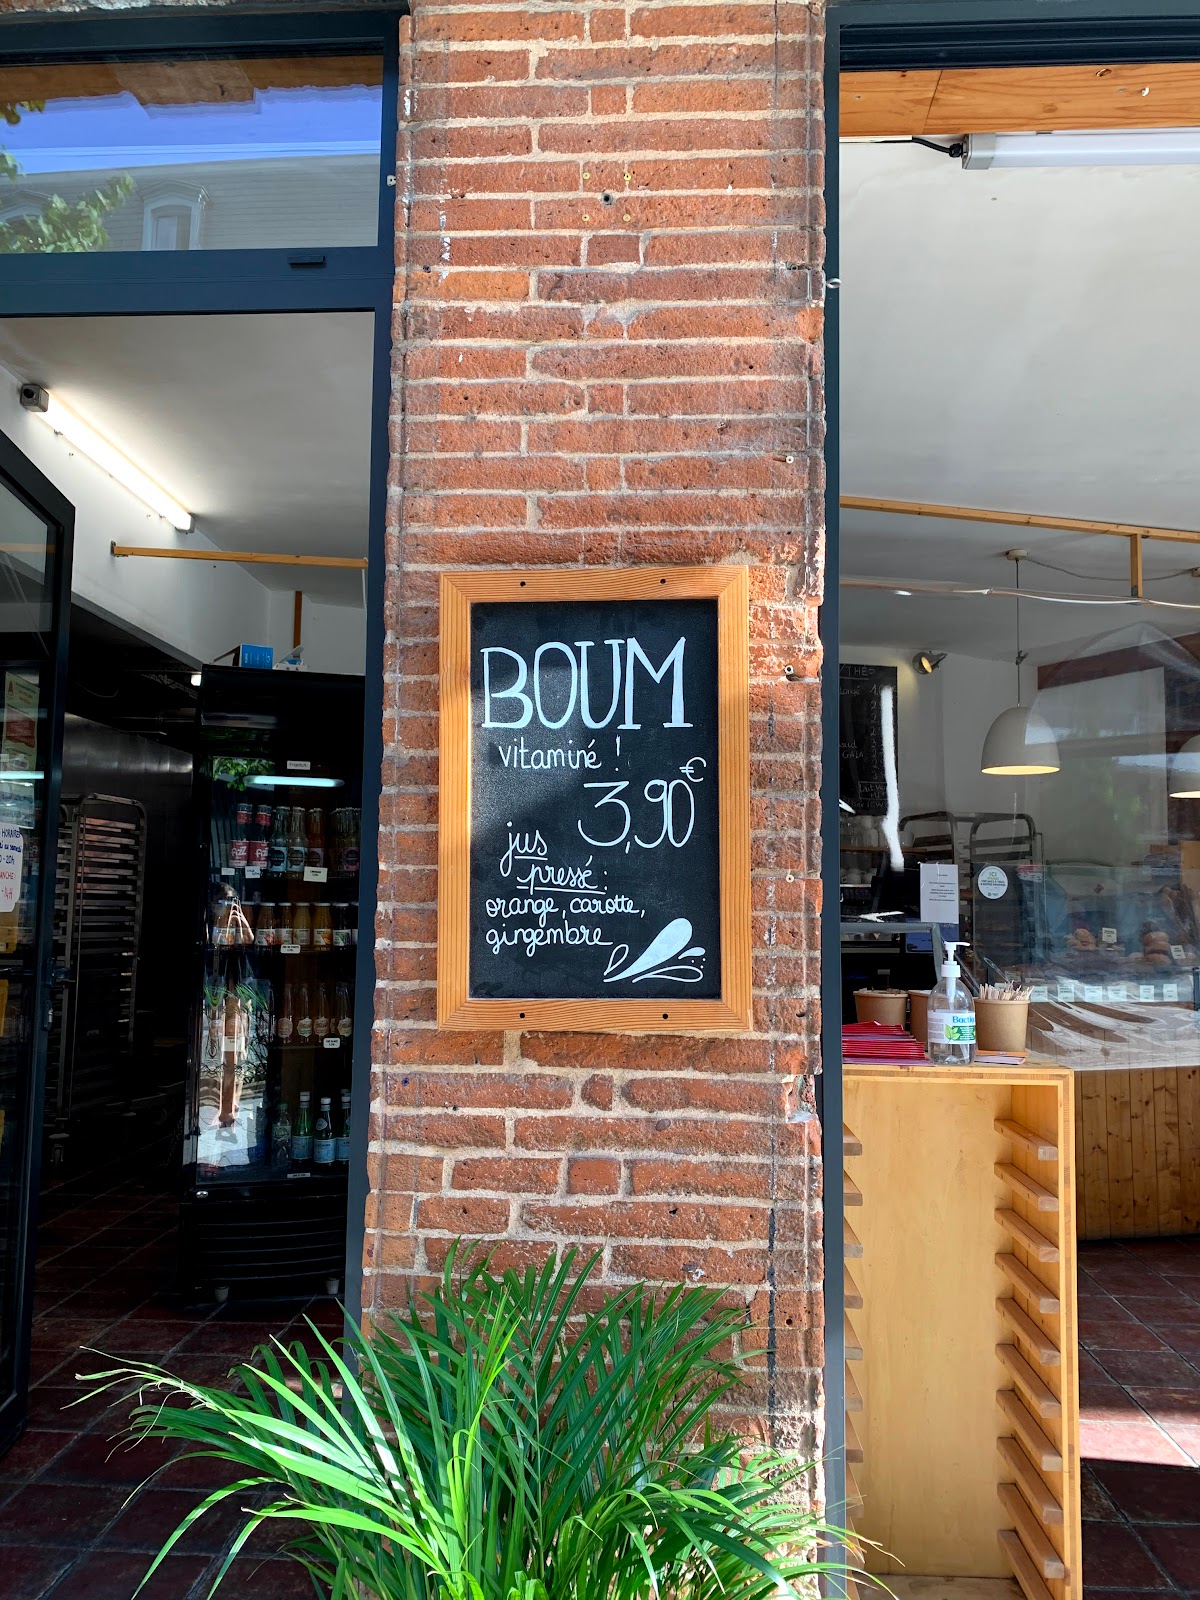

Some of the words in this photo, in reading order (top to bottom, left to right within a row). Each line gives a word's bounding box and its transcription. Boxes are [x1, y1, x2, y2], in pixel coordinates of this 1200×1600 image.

[480, 636, 693, 730] BOUM
[498, 736, 602, 771] vitaminé
[500, 821, 549, 878] jus
[485, 920, 614, 957] gingembre
